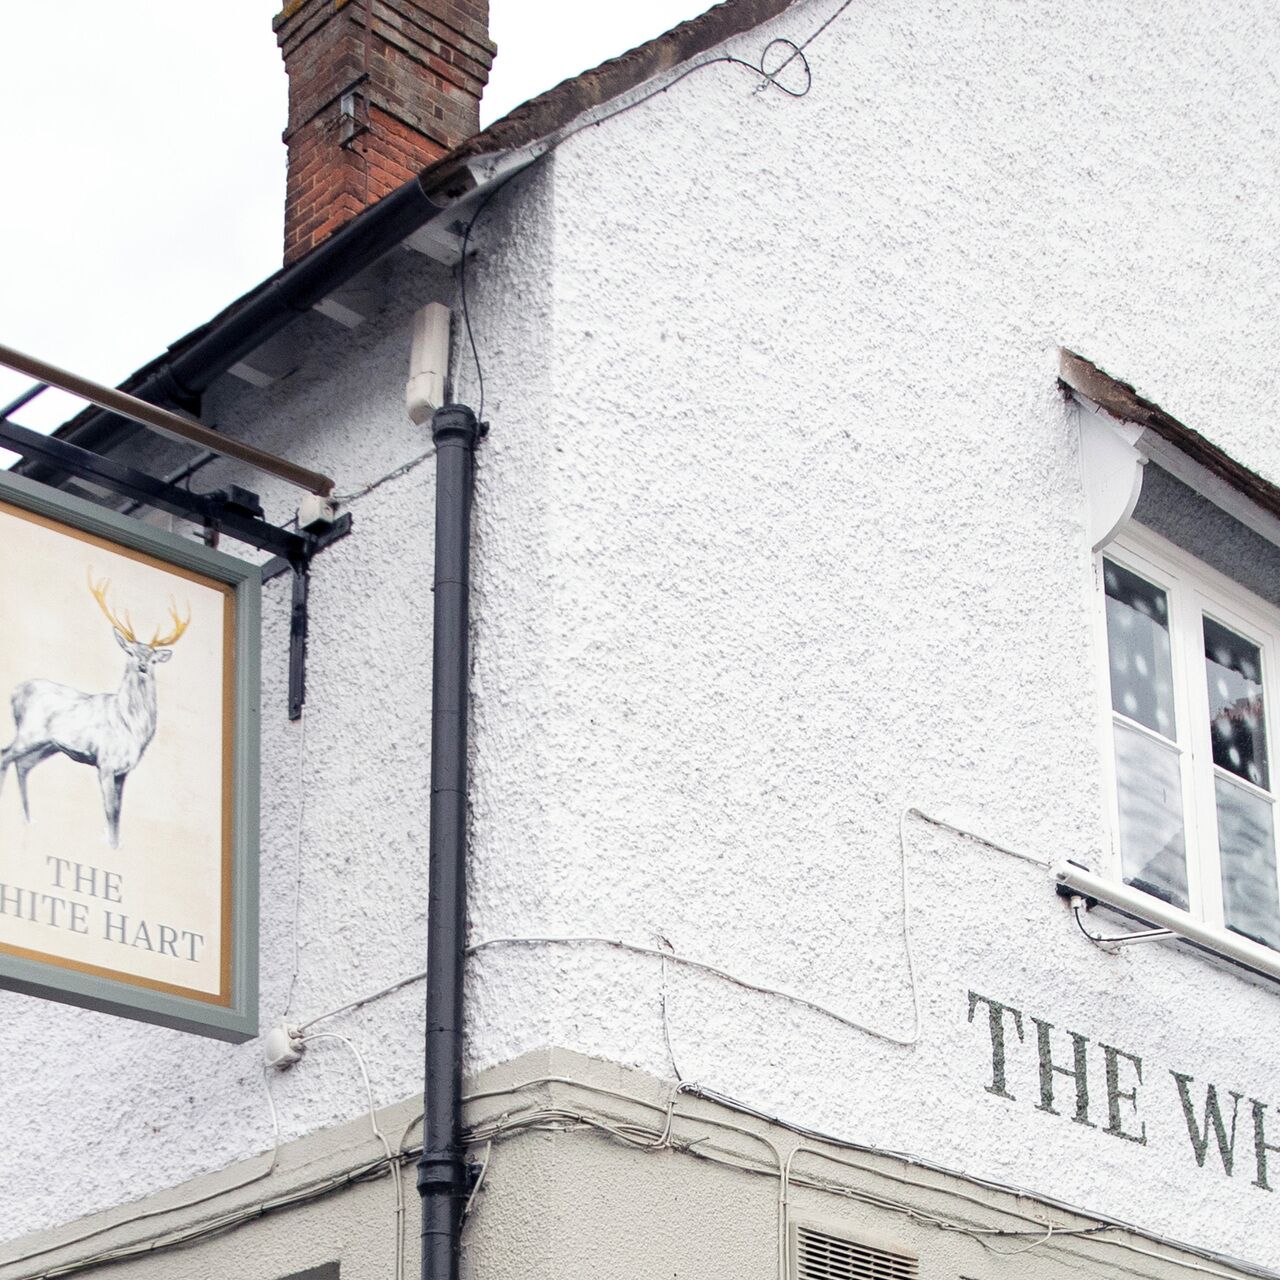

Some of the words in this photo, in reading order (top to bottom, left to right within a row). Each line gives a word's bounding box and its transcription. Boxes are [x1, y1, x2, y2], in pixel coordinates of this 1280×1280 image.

[45, 855, 123, 904] THE
[102, 910, 205, 963] HART
[967, 989, 1148, 1146] THE
